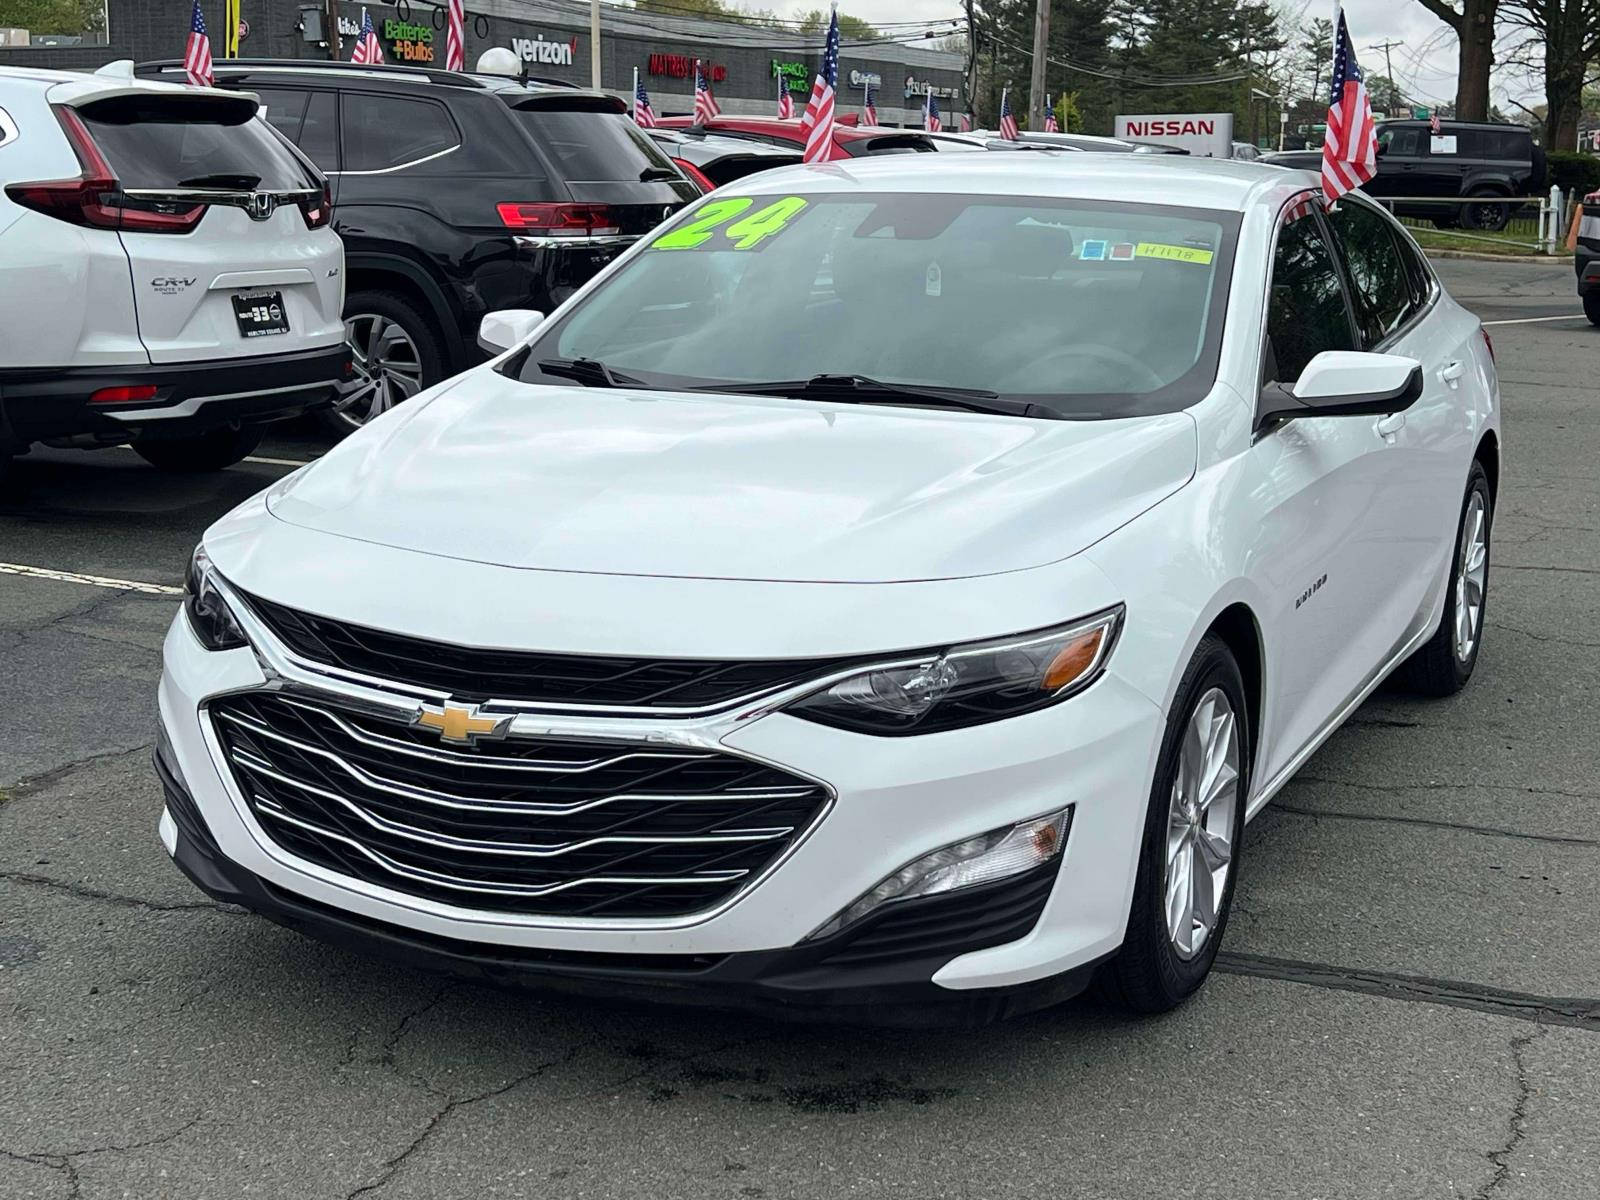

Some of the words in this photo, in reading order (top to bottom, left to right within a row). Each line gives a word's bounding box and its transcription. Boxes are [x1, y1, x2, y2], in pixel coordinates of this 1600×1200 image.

[384, 18, 434, 42] Batteries
[511, 33, 573, 65] verizon
[1126, 120, 1215, 136] NISSAN
[651, 196, 809, 250] 24
[151, 277, 197, 287] CR-V
[251, 306, 271, 322] 33
